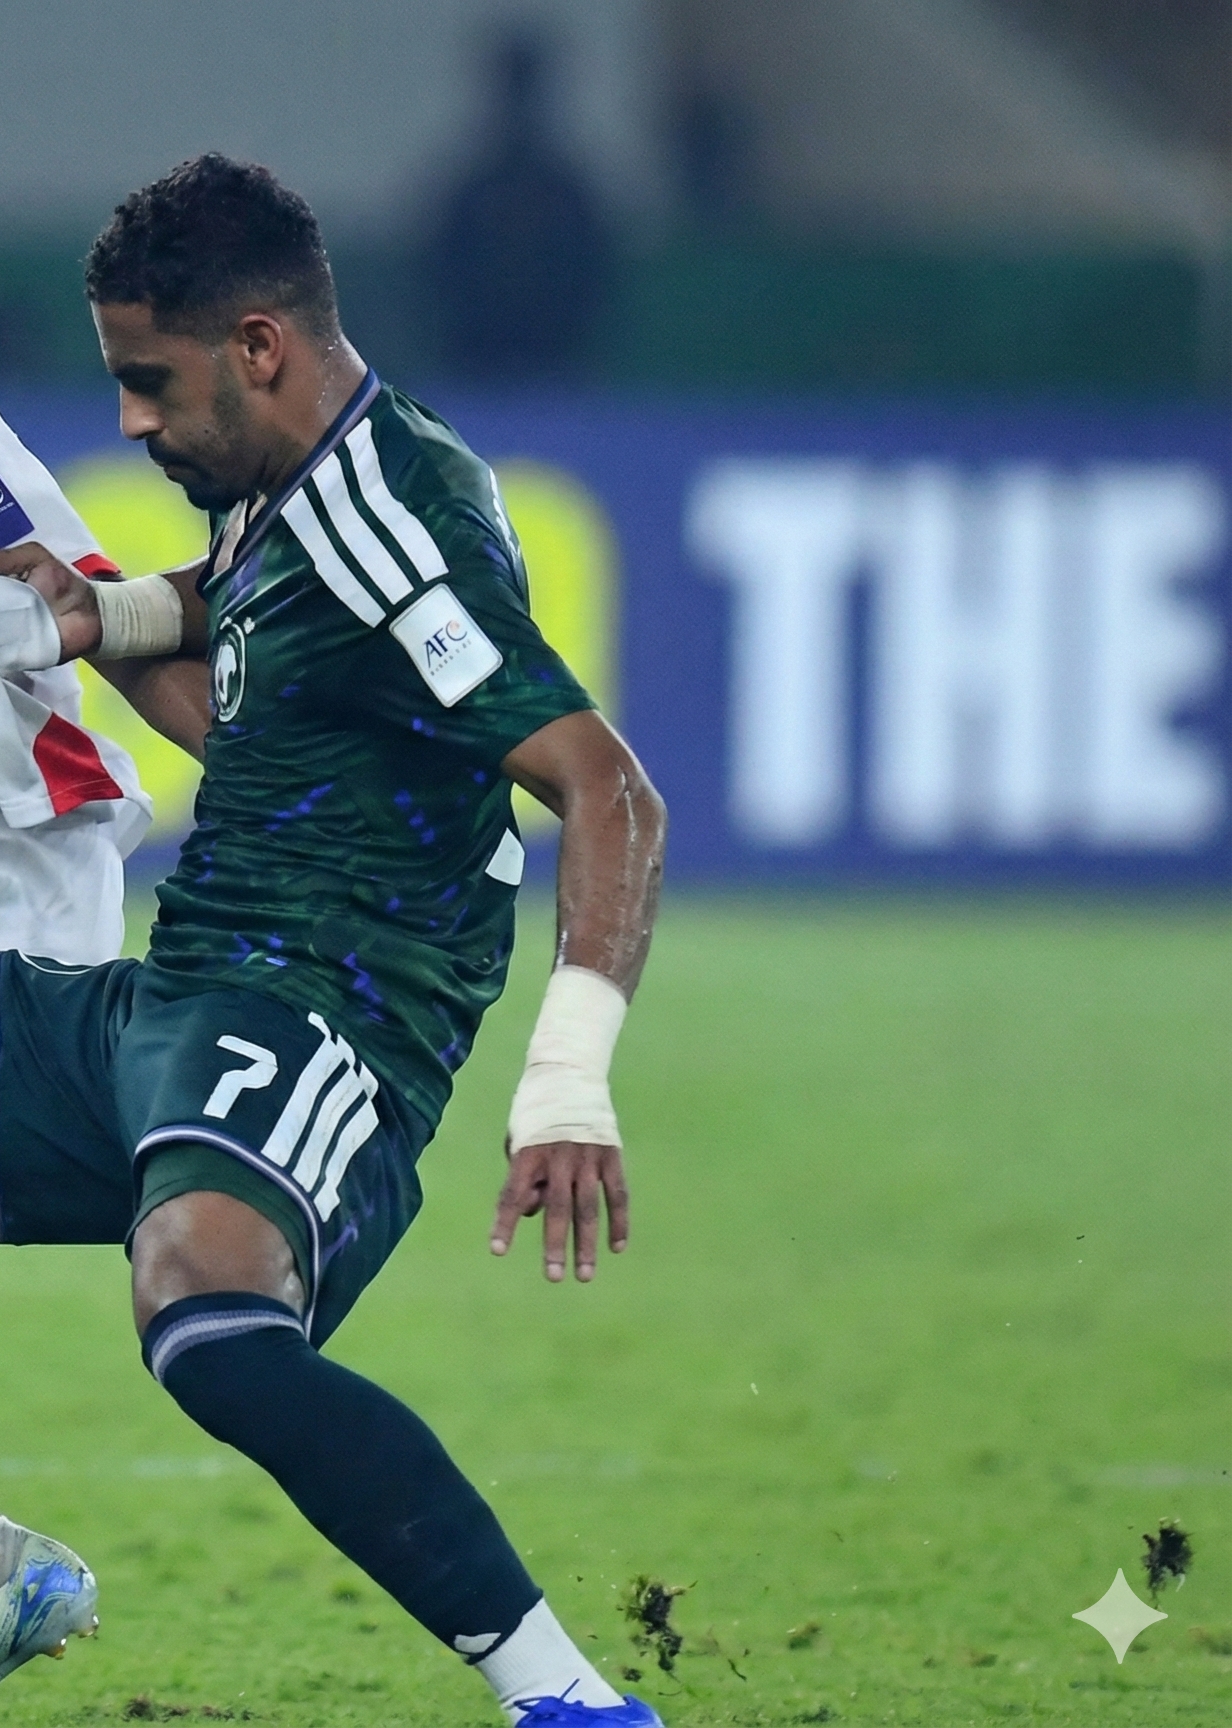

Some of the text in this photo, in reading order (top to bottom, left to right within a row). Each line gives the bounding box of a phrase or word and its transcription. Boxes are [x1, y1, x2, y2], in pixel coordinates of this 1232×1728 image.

[424, 619, 468, 668] AFC
[685, 458, 1225, 850] THE
[203, 1035, 279, 1120] 7
